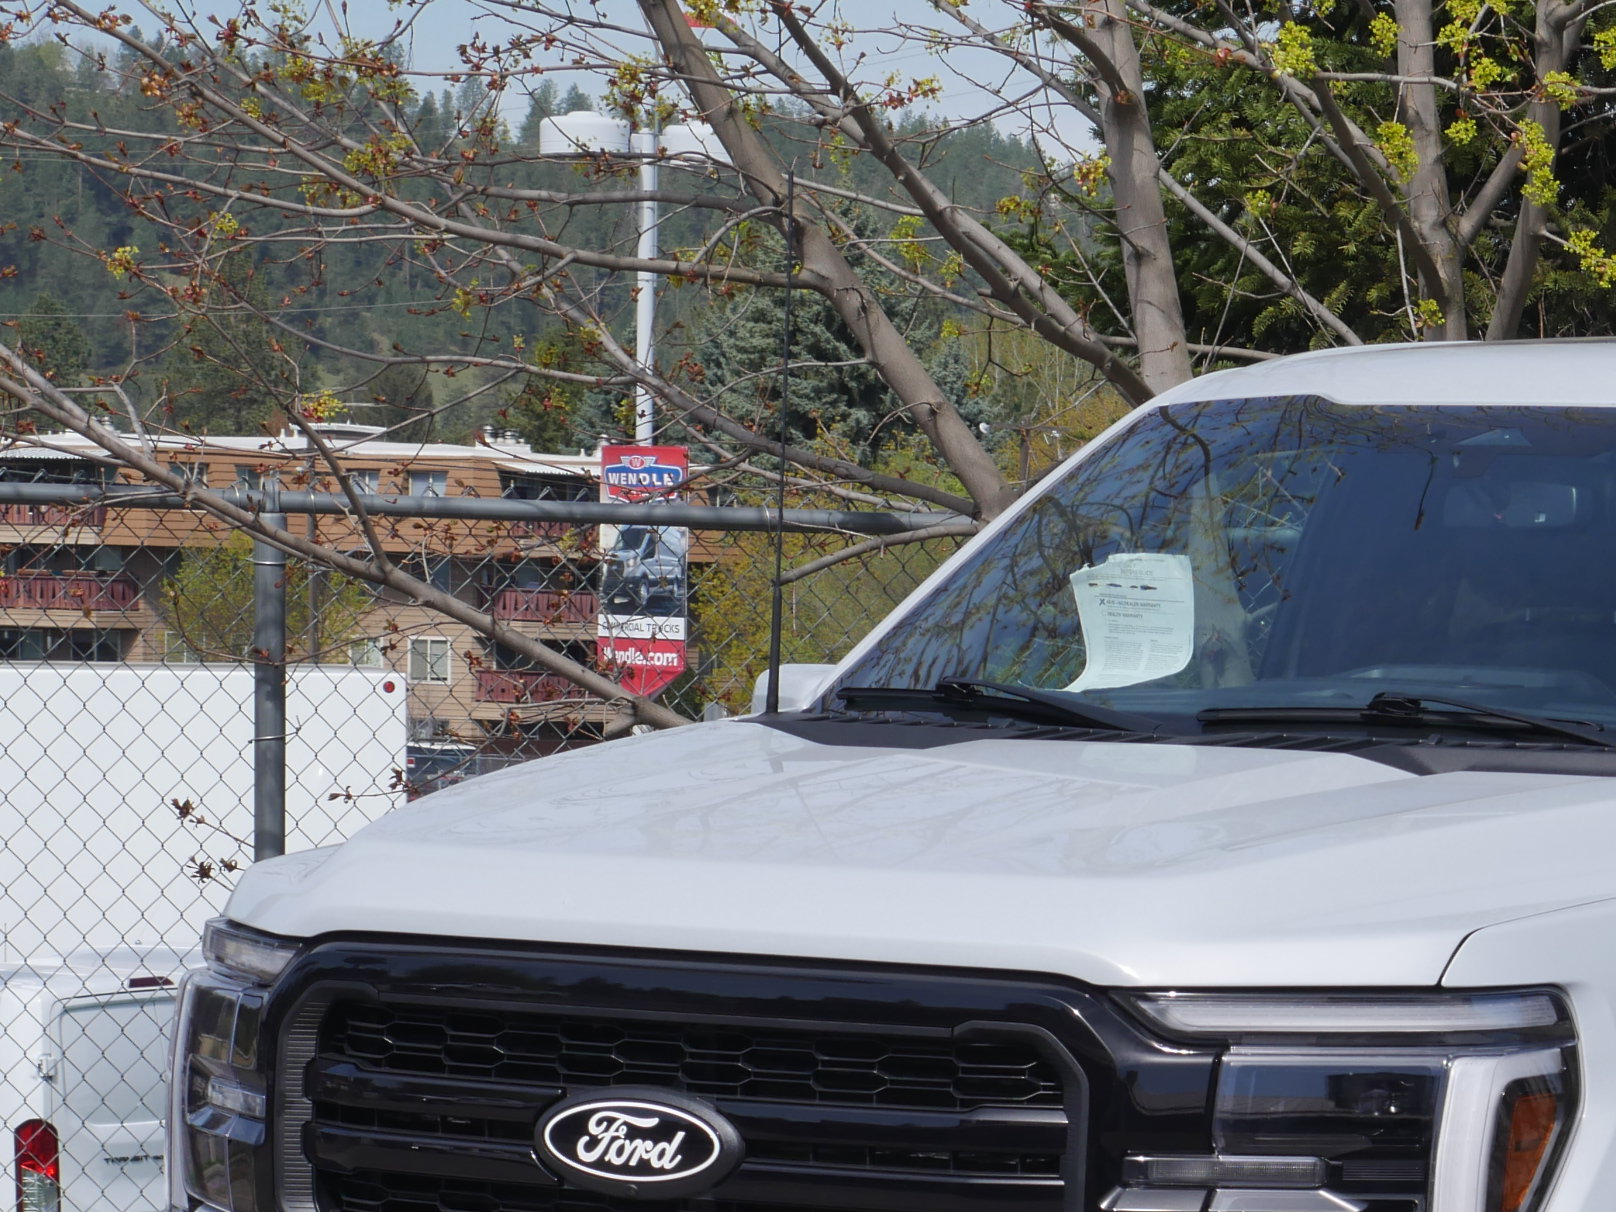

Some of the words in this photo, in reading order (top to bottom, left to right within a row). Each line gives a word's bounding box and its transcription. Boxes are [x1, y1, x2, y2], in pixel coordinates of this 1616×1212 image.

[608, 472, 674, 486] WENDLE
[603, 647, 678, 666] Wndle.com
[576, 1111, 686, 1170] Ford
